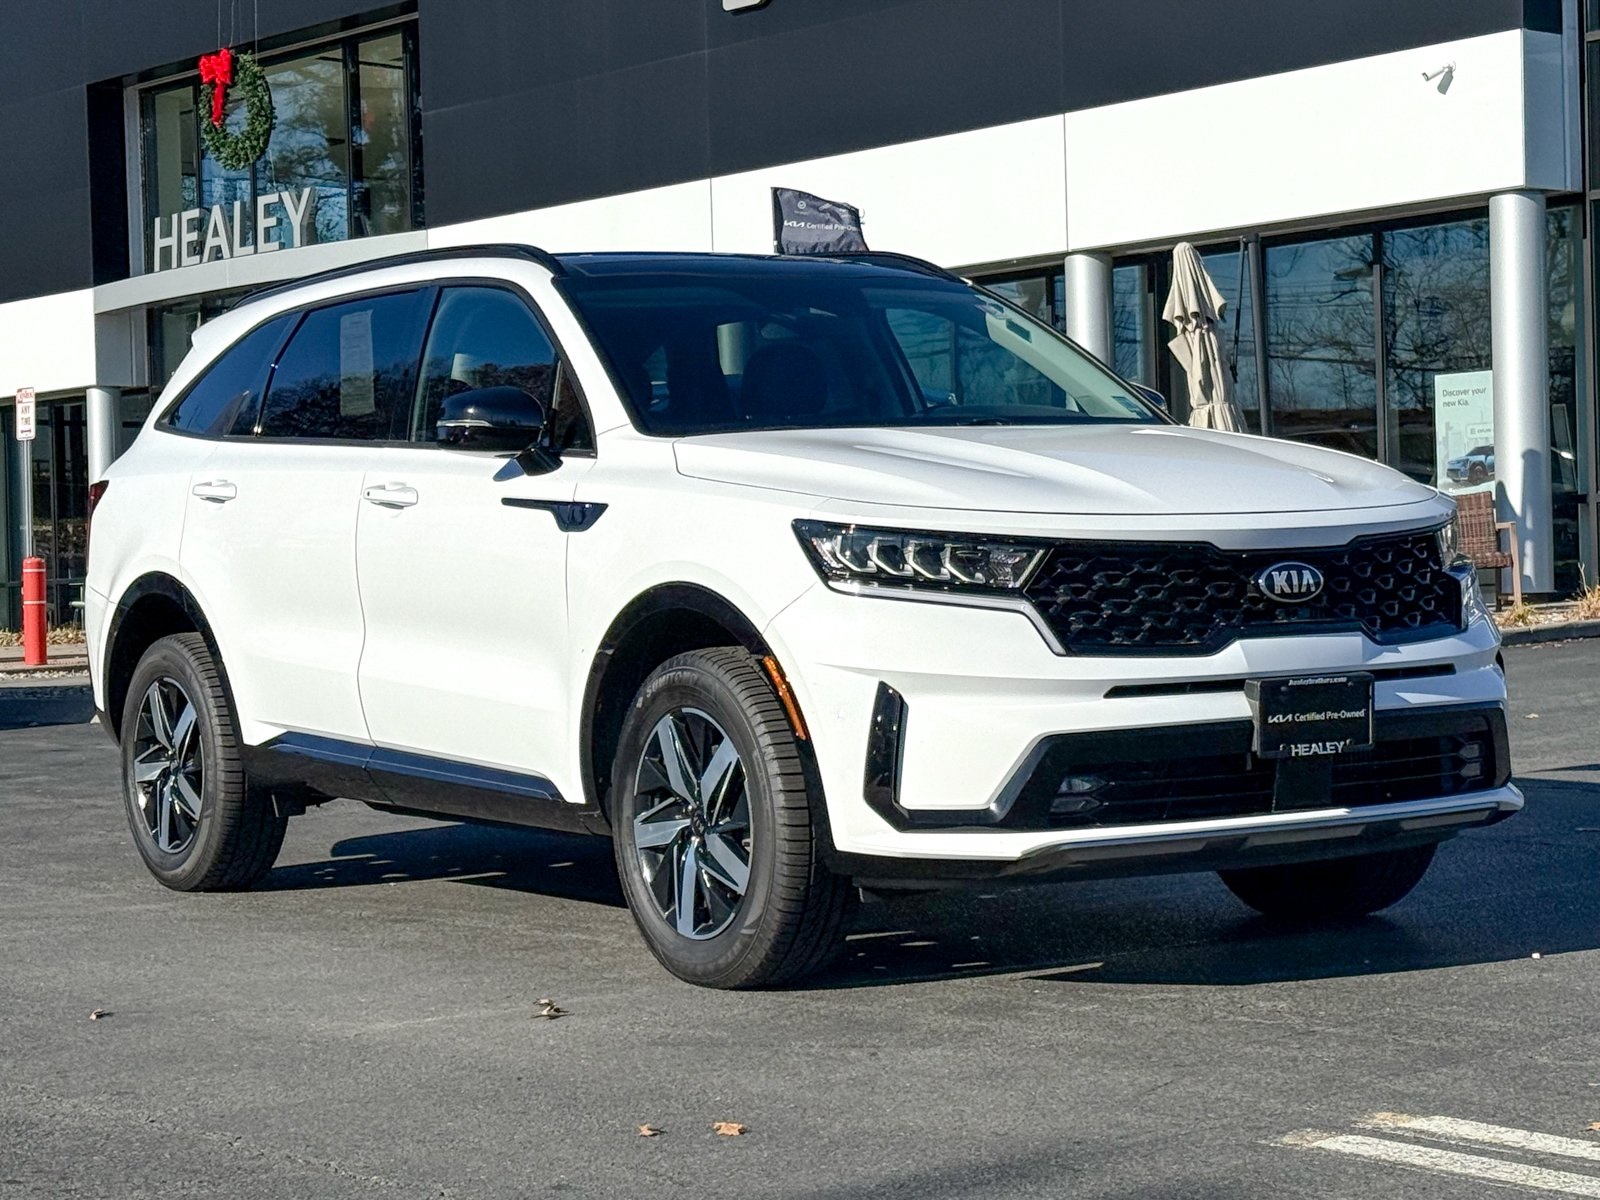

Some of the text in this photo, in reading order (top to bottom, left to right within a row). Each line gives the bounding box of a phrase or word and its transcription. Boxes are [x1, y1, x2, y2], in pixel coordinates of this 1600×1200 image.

[154, 187, 313, 272] HEALEY
[806, 222, 833, 230] Certified
[1442, 387, 1486, 397] Discover your
[1442, 399, 1469, 408] new Kia.
[1271, 570, 1316, 594] KIA
[1268, 709, 1365, 723] KIA Certified Pre-Owned
[1290, 741, 1345, 756] HEALEY
